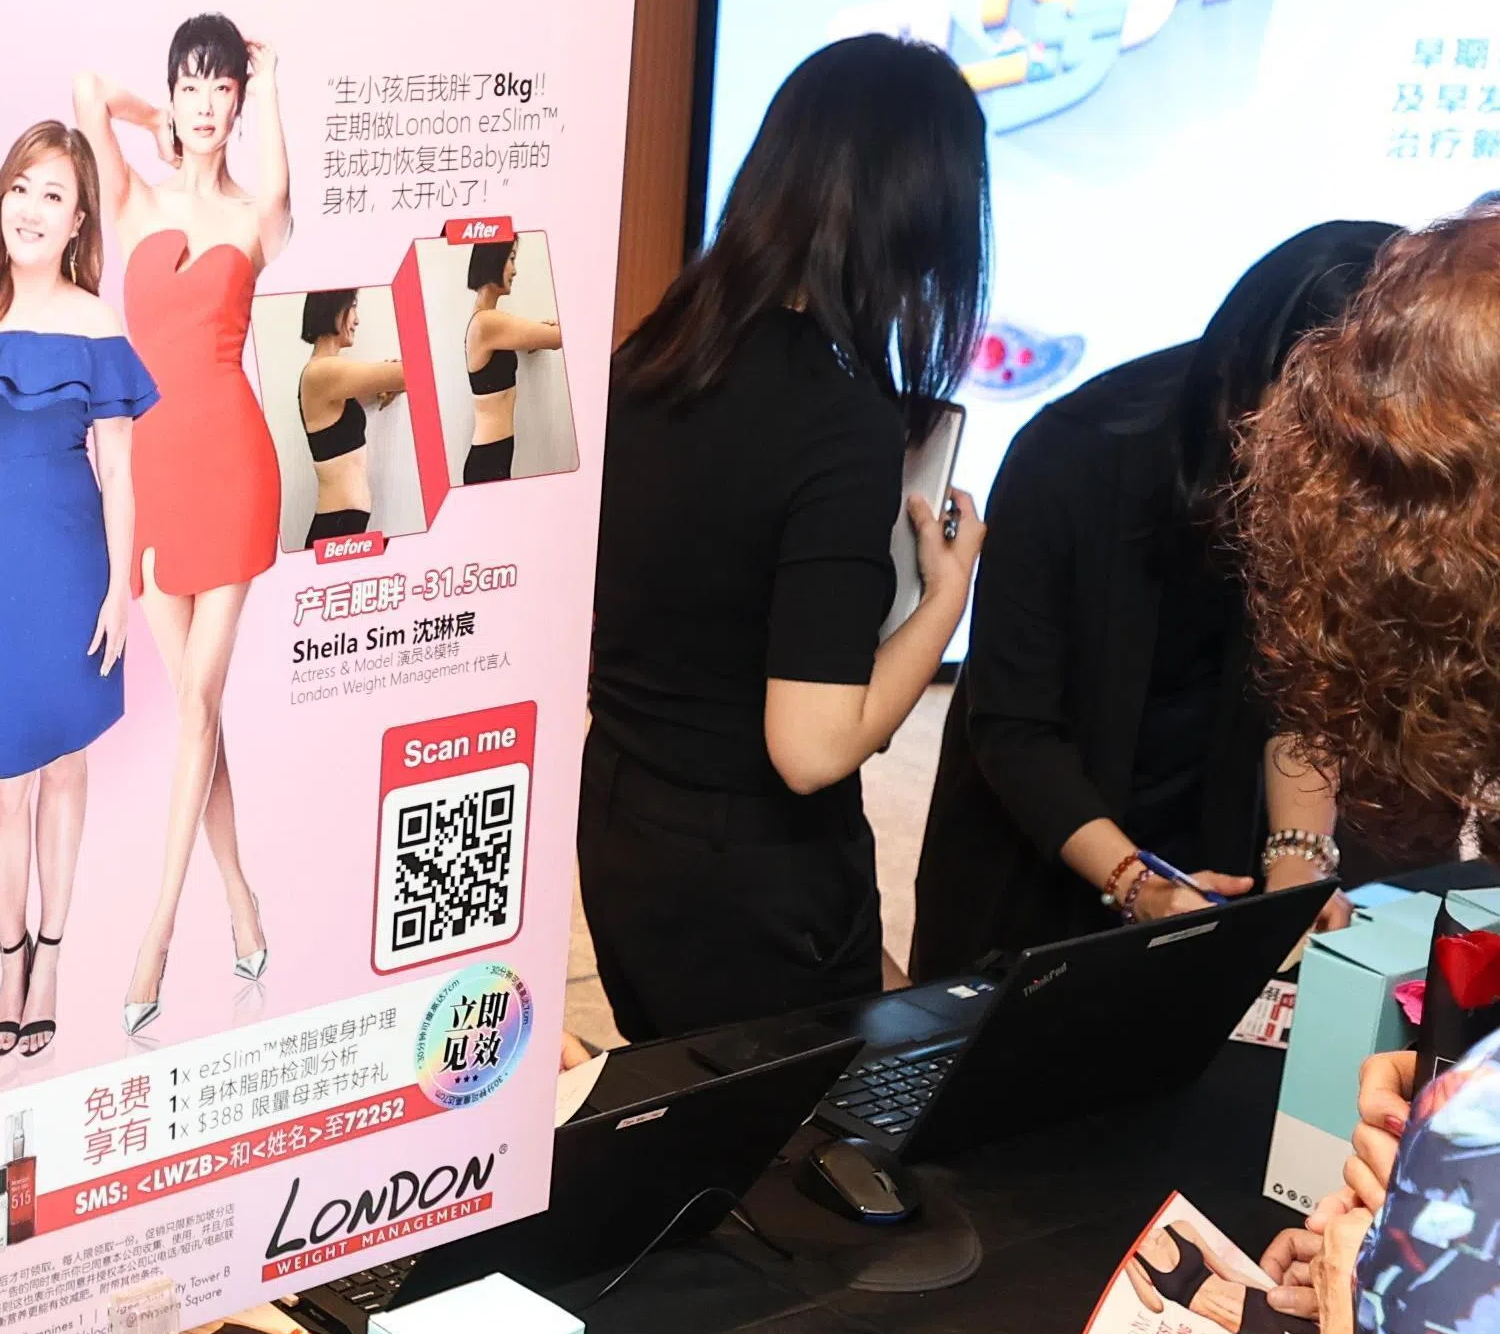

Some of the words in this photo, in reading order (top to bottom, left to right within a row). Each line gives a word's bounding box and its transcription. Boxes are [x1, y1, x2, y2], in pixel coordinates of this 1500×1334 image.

[462, 221, 499, 239] After
[324, 538, 373, 559] Before
[294, 572, 406, 627] 产后肥胖
[412, 563, 518, 603] -31.5cm
[293, 632, 358, 663] Sheila
[366, 626, 406, 650] Sim
[473, 651, 512, 674] 代言人
[291, 665, 335, 684] Actress
[354, 653, 394, 673] Model
[403, 735, 469, 768] Scan
[477, 726, 517, 754] me
[444, 991, 510, 1033] 立即
[439, 1030, 502, 1074] 见效
[198, 1106, 243, 1133] $388
[252, 1061, 388, 1118] 限量母亲节好礼
[199, 1043, 358, 1109] 身体脂肪检测分析
[84, 1074, 151, 1127] 免费
[83, 1117, 151, 1166] 享有
[74, 1181, 129, 1216] SMS:
[277, 1241, 347, 1276] WEIGHT
[362, 1198, 483, 1255] MANAGEMENT
